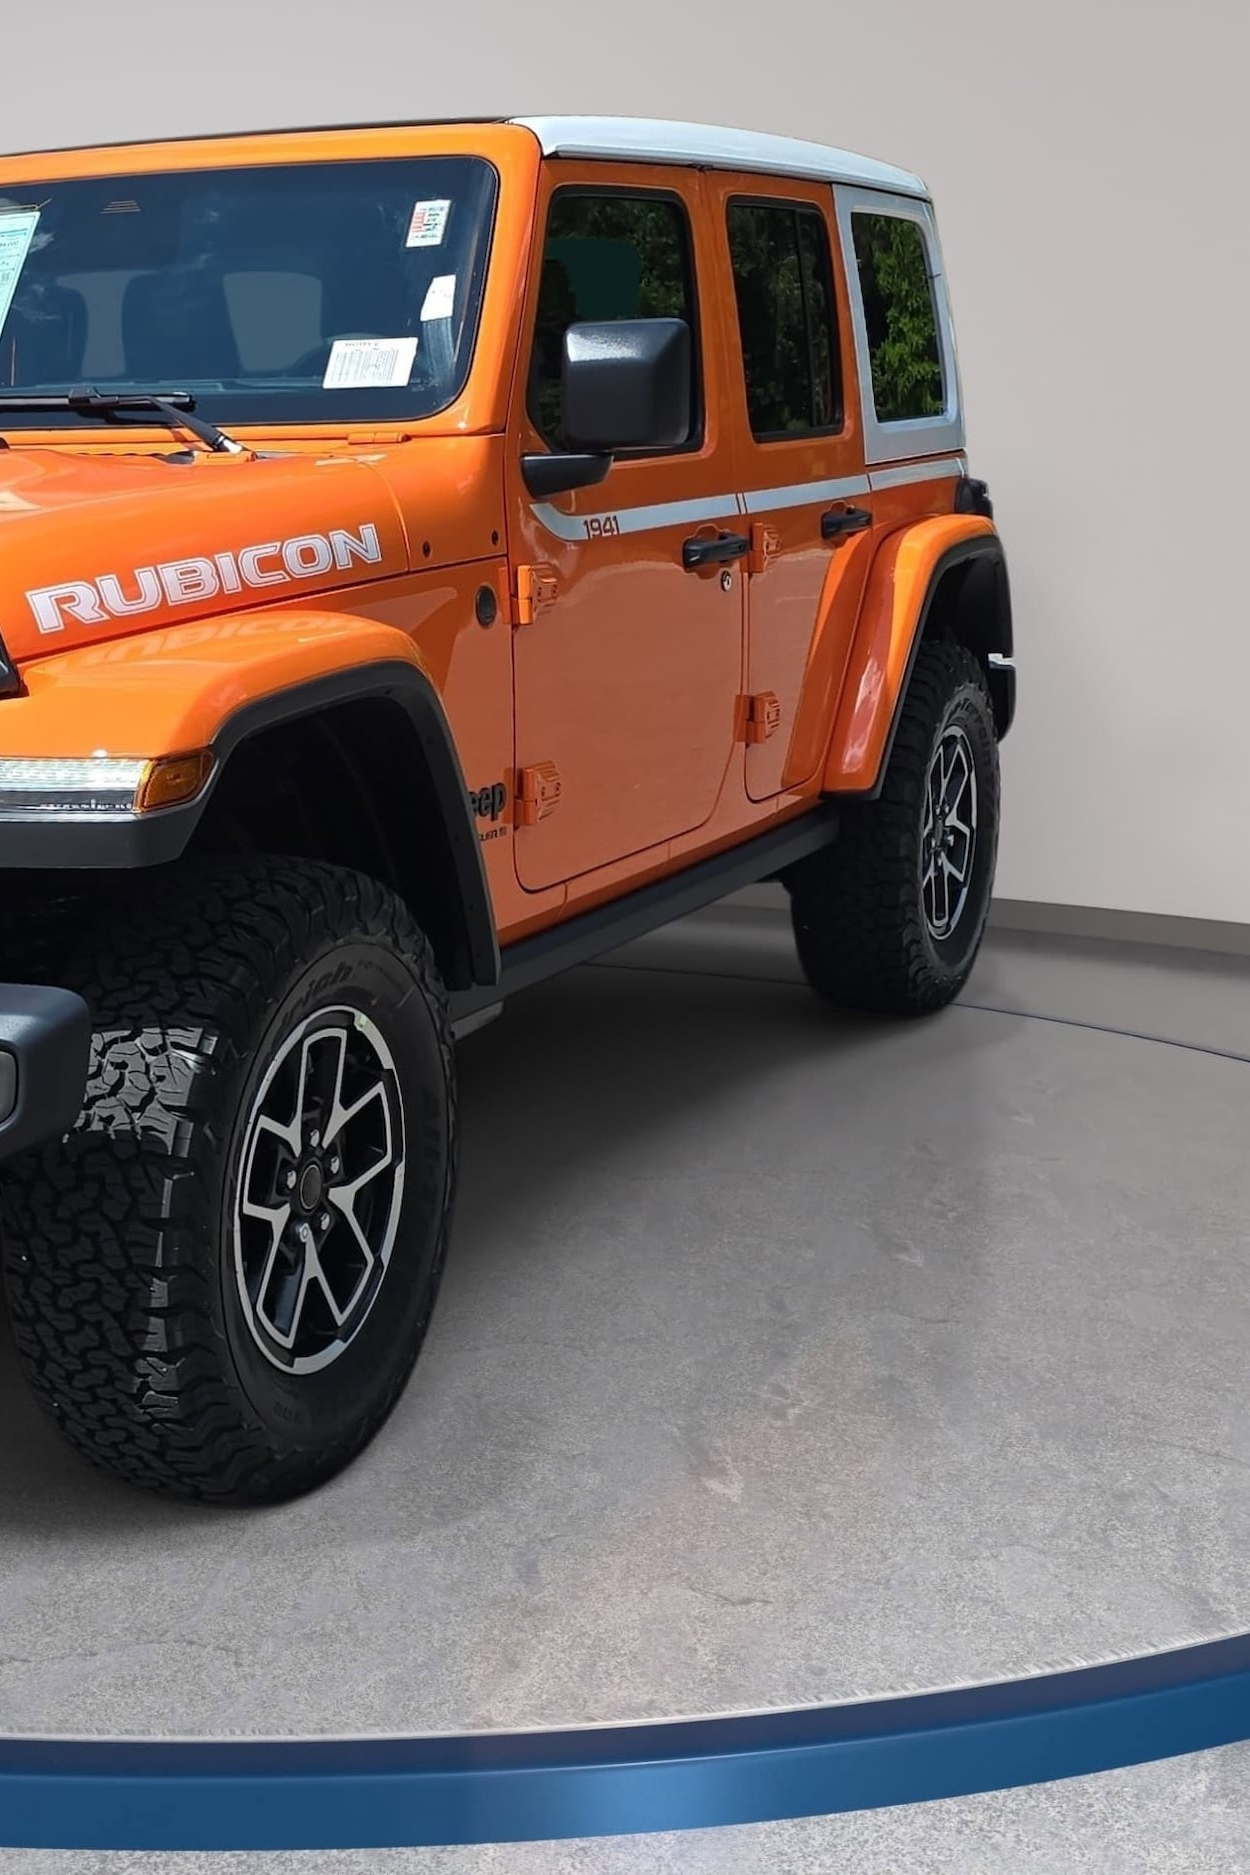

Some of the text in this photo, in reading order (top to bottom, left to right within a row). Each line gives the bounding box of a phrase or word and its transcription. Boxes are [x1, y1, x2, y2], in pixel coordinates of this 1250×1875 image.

[583, 515, 620, 540] 1941
[25, 523, 383, 634] RUBICON
[468, 782, 507, 822] eep
